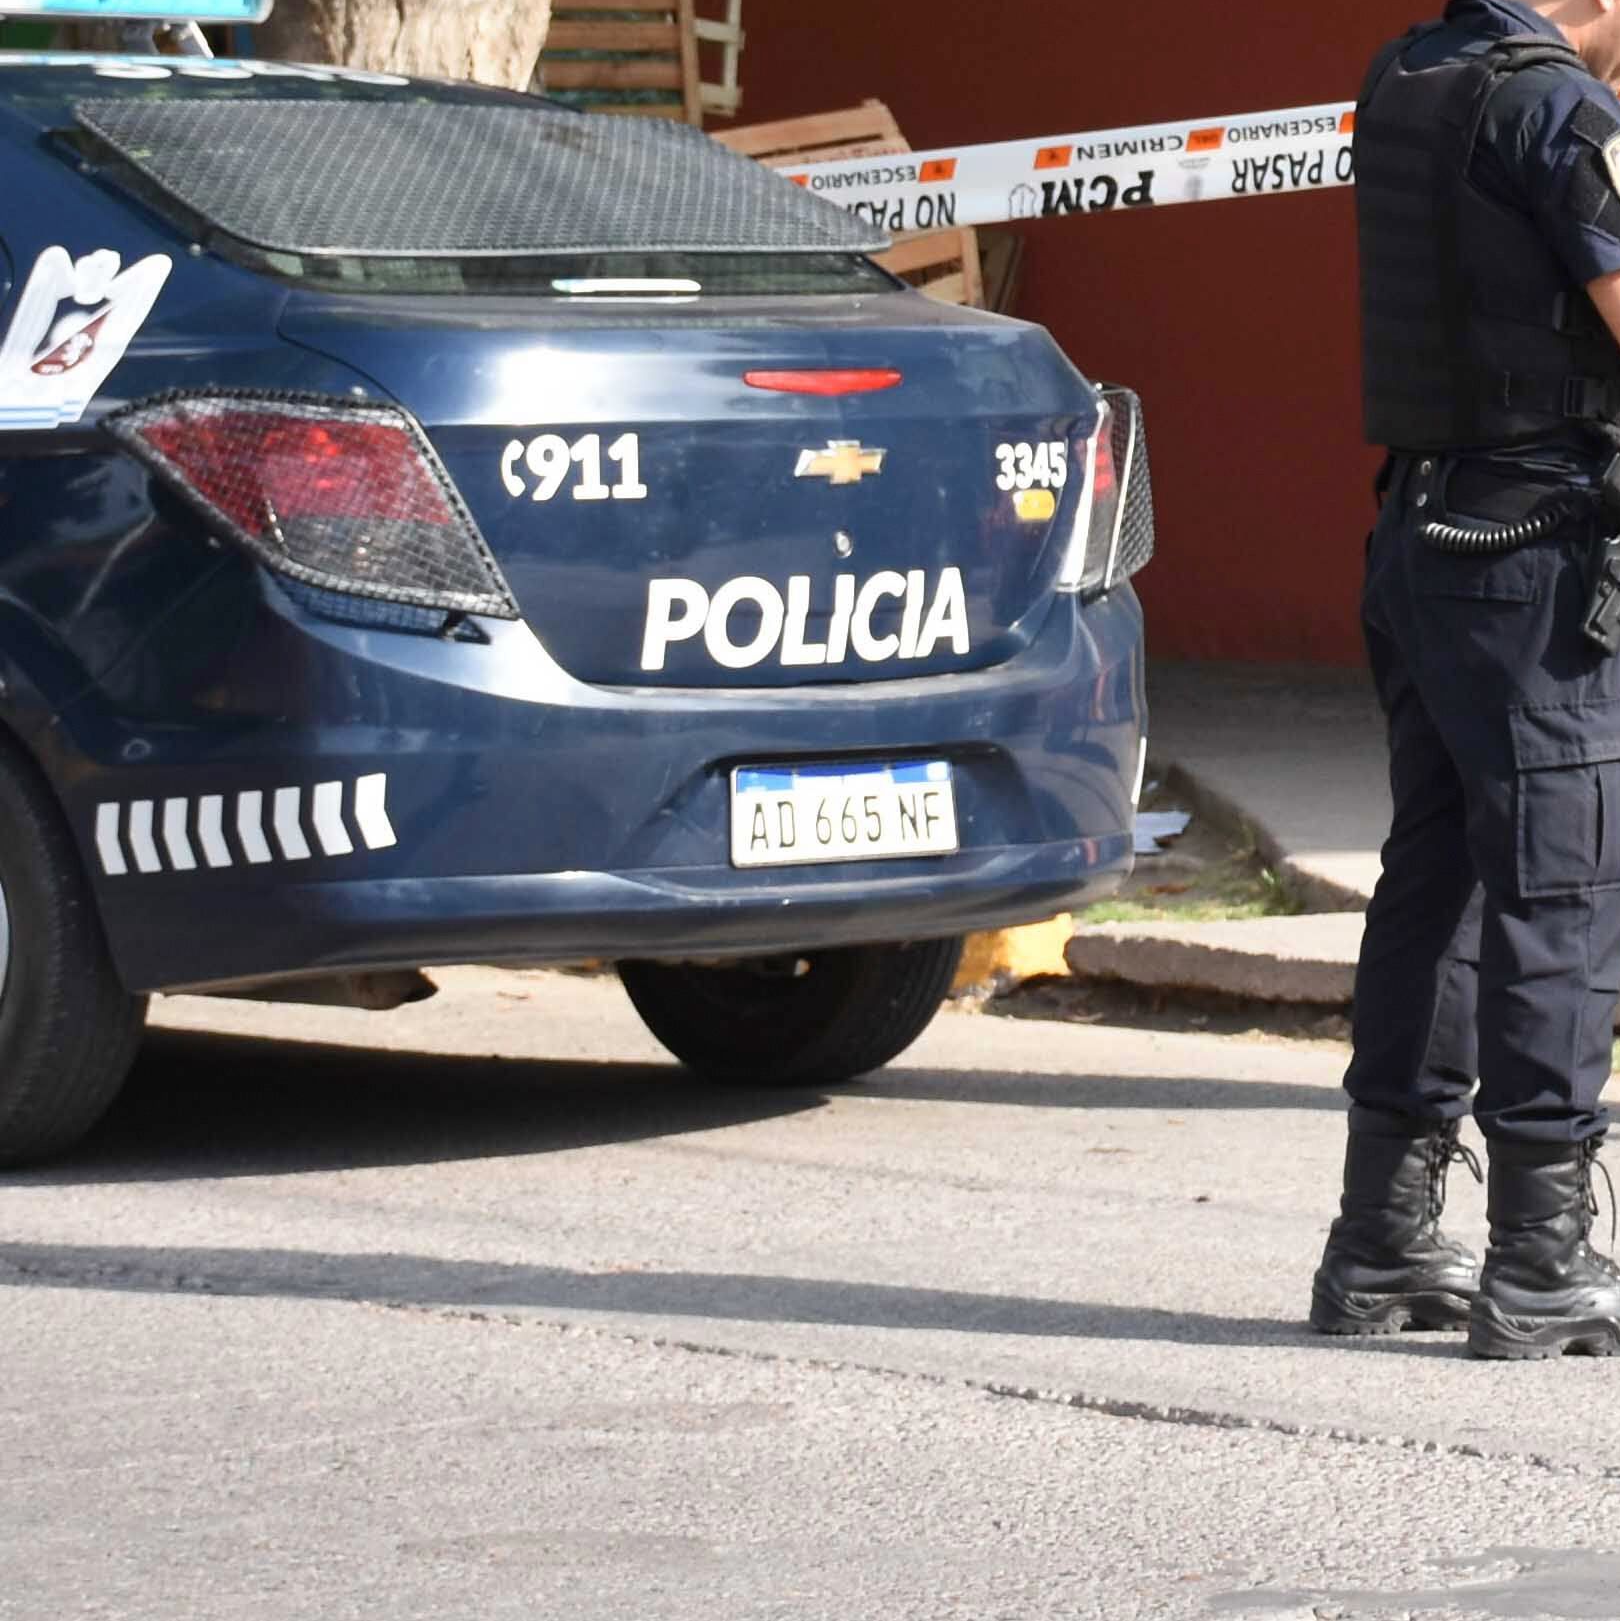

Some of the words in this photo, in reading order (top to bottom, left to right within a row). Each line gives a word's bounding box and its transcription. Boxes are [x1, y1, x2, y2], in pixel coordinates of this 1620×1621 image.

[1076, 134, 1184, 161] CRIMEN
[1227, 116, 1337, 143] ESCENARIO
[811, 164, 917, 191] ESCENARIO
[1231, 148, 1324, 191] PASAR
[1335, 145, 1354, 182] O
[915, 192, 956, 228] NO
[1041, 169, 1155, 216] PCM
[526, 433, 648, 501] 911
[995, 442, 1068, 492] 3345
[640, 566, 971, 671] POLICIA
[749, 803, 798, 851] AD
[815, 797, 884, 845] 665
[896, 790, 942, 841] NF
